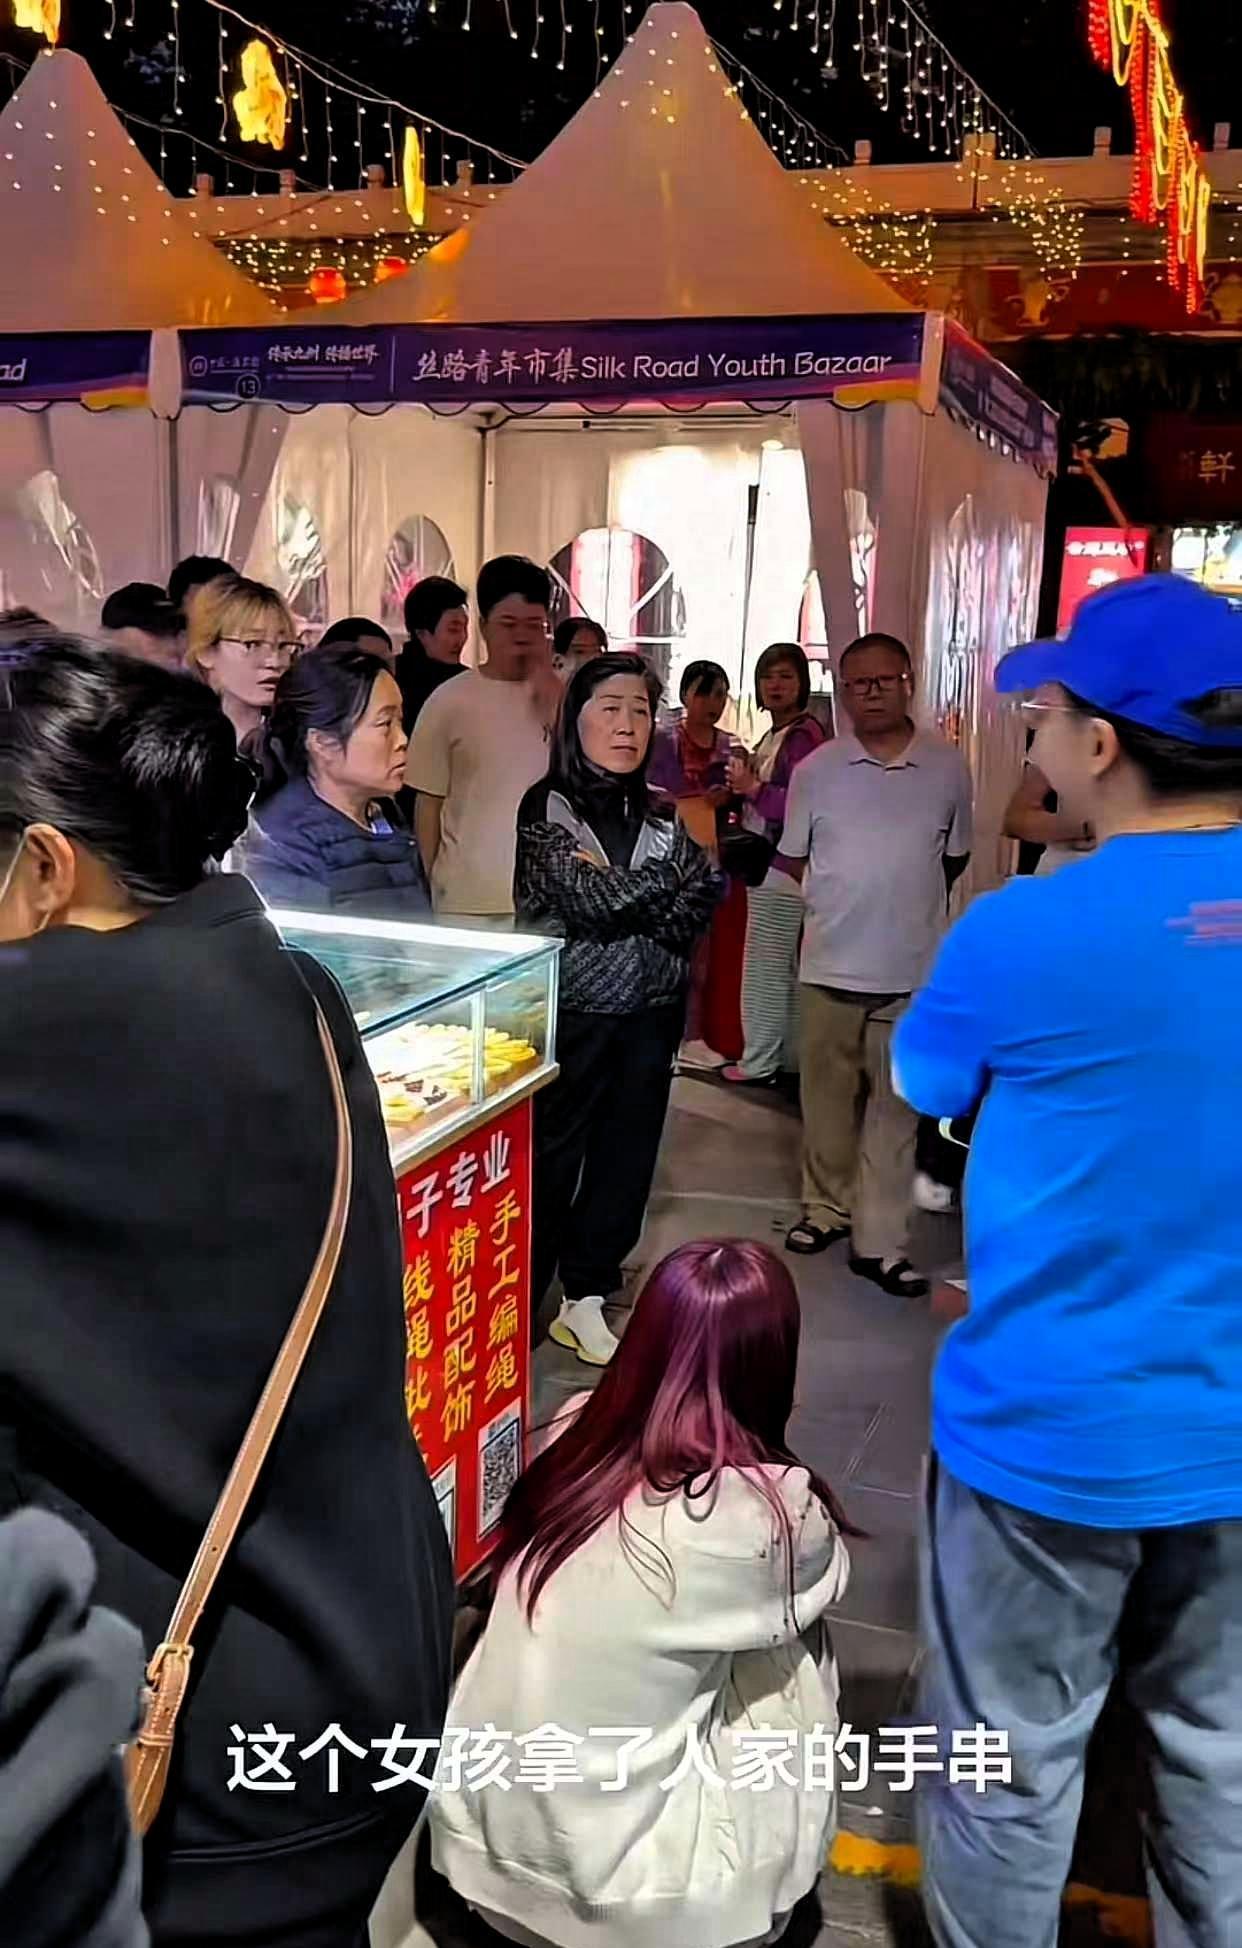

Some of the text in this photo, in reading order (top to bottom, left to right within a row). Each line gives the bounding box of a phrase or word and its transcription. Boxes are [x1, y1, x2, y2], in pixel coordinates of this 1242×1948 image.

[412, 347, 893, 384] 丝路青年市集 Silk Road Youth Bazaar
[406, 1129, 511, 1239] 子专业
[439, 1217, 481, 1443] 精品配饰
[483, 1188, 522, 1404] 手工编绳
